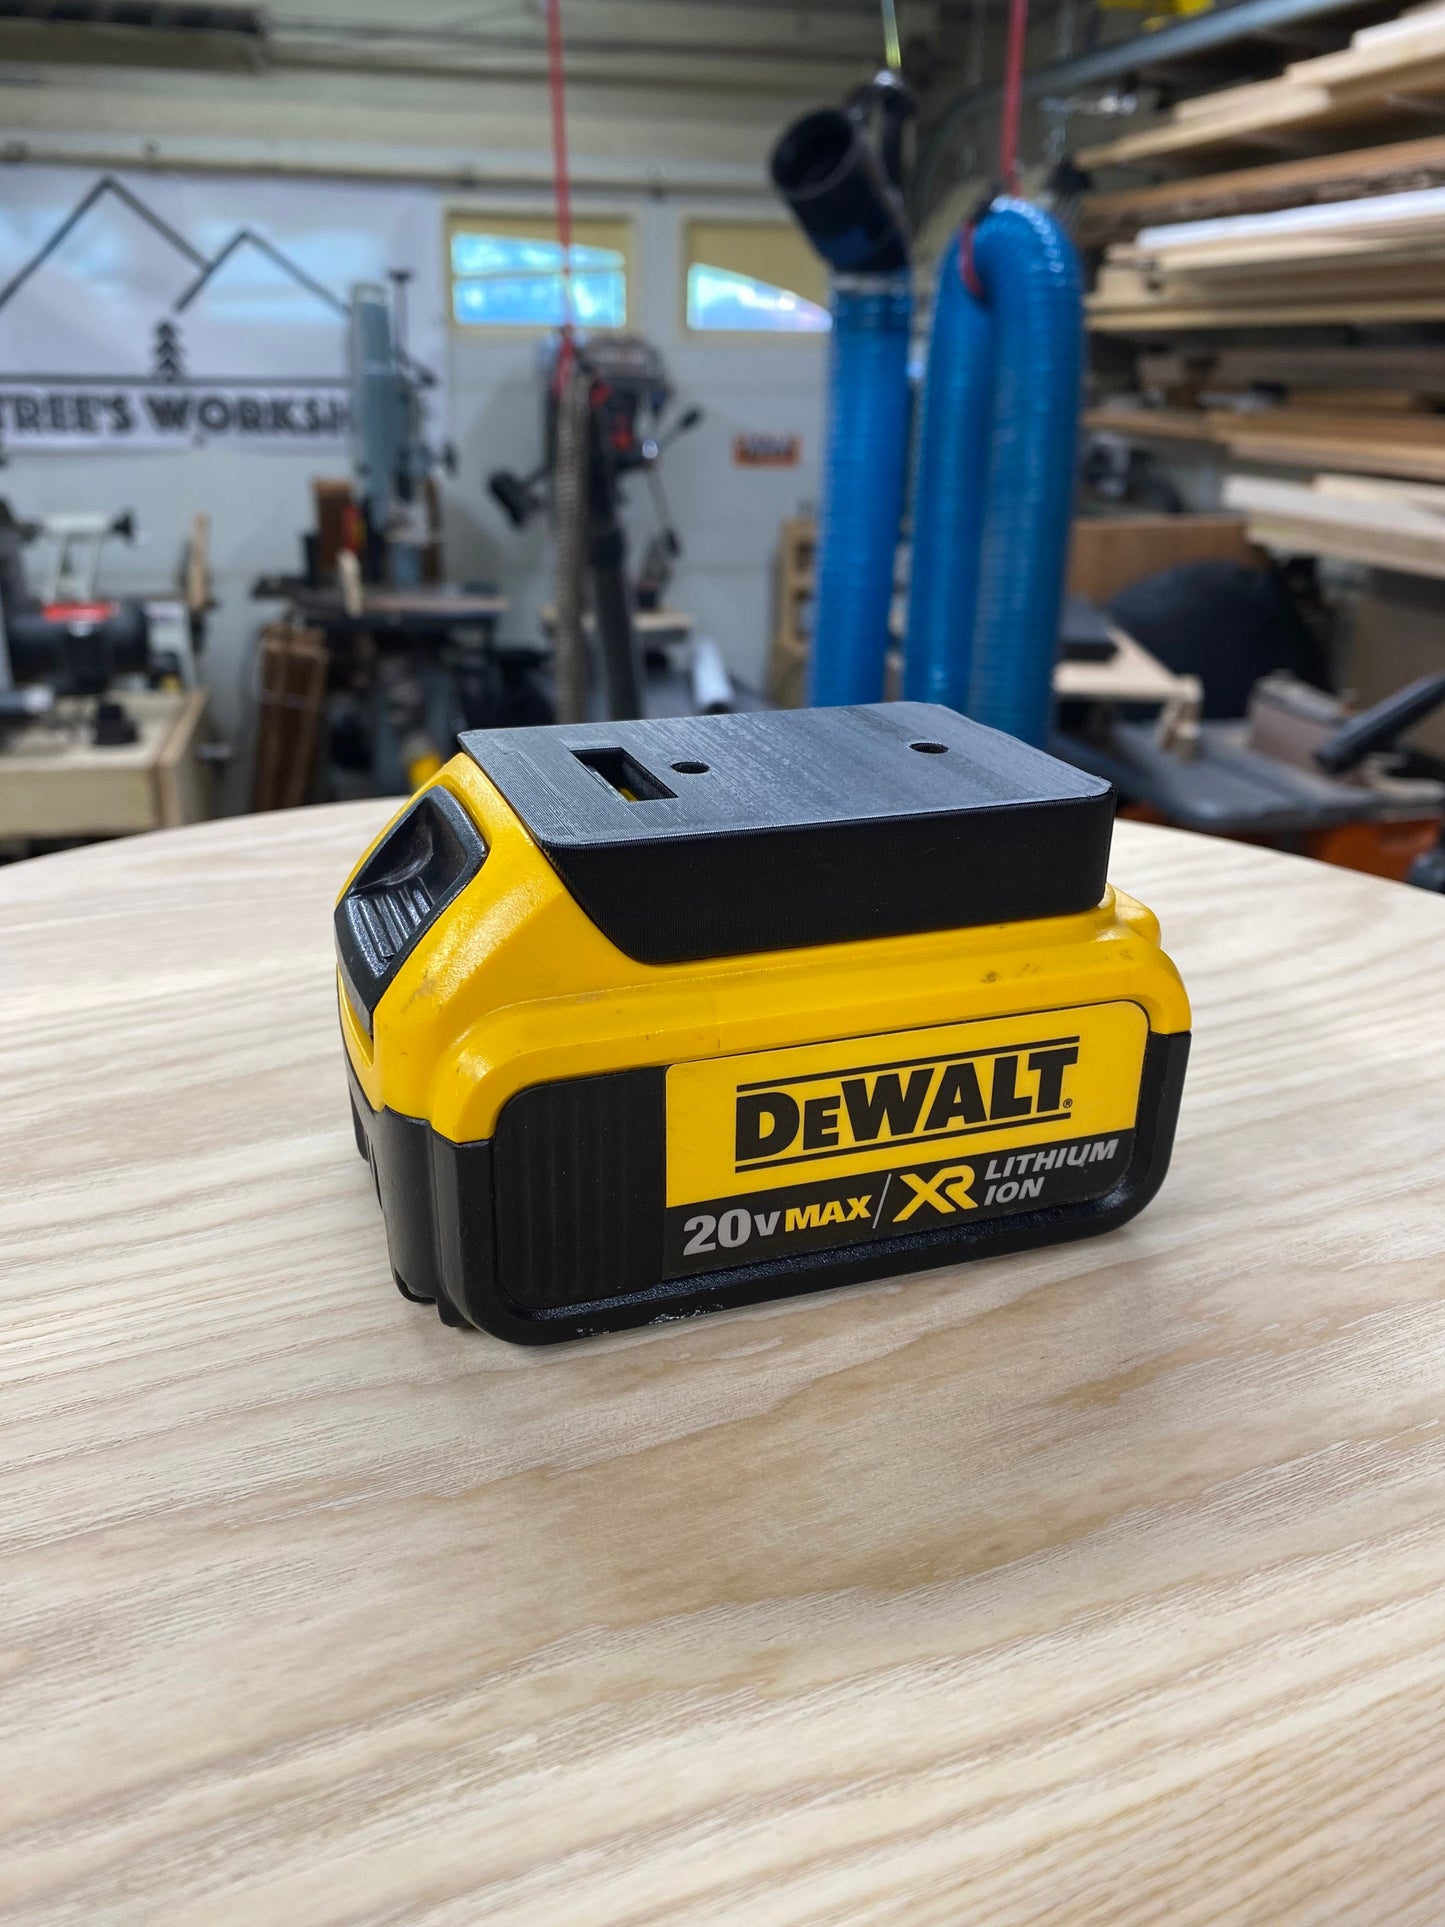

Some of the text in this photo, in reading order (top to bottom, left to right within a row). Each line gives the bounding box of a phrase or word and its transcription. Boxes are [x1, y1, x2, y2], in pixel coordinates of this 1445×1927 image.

[983, 1139, 1118, 1180] LITHIUM
[785, 1195, 872, 1233] MAX
[892, 1164, 977, 1223] XR
[985, 1178, 1045, 1206] ION
